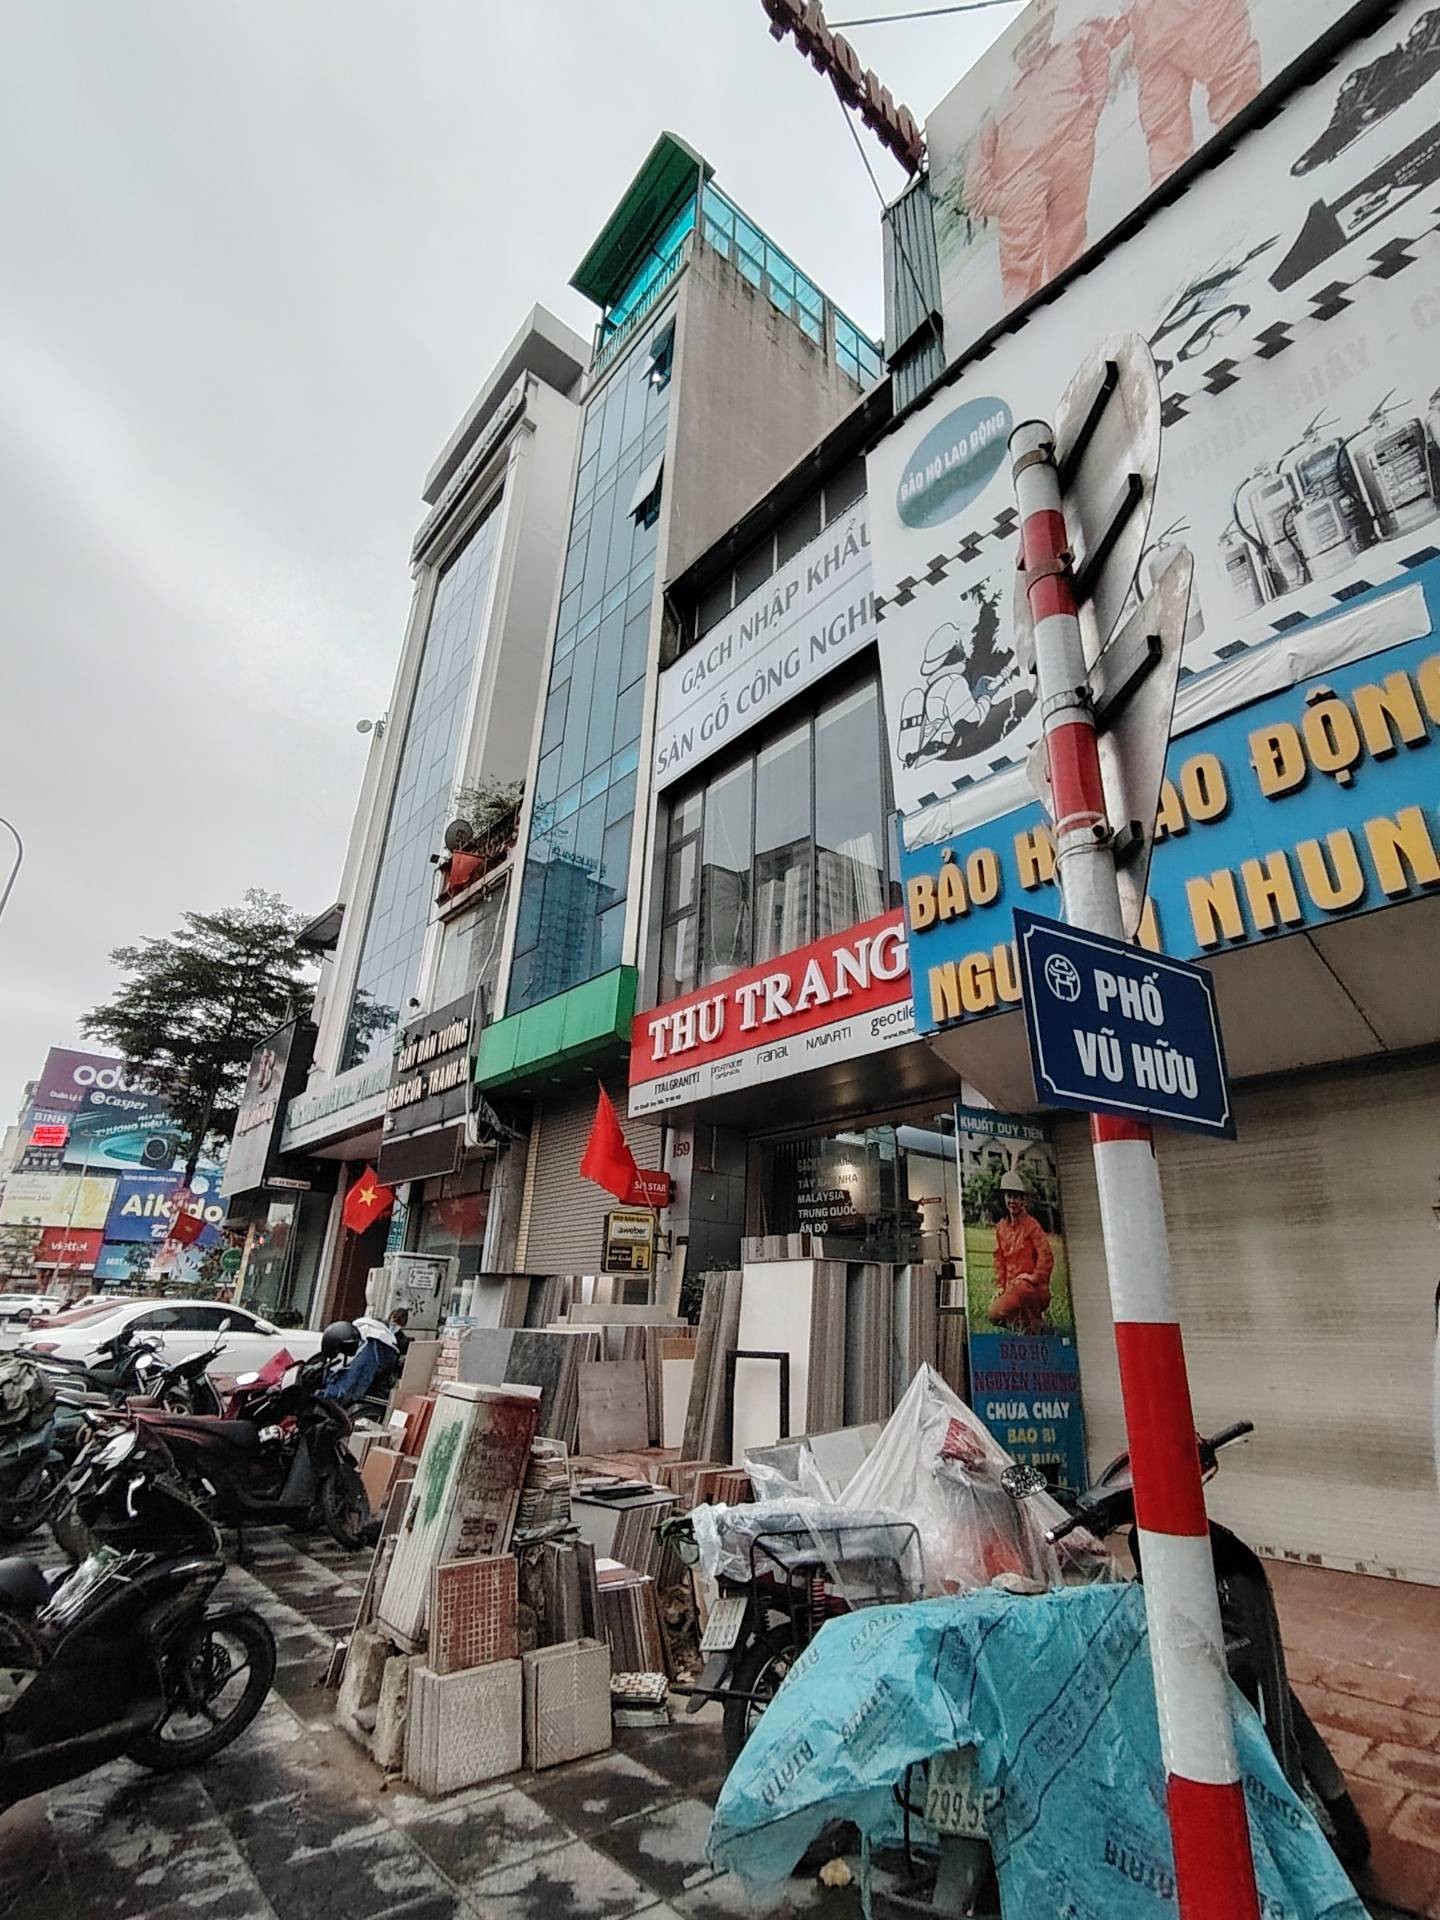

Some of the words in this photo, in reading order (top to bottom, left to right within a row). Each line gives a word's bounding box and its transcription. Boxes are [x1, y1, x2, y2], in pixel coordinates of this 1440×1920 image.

[944, 439, 967, 468] LAO
[969, 410, 1005, 449] ĐỘNG
[681, 635, 732, 694] GẠCH
[739, 580, 799, 649] NHẬP
[701, 691, 729, 742] GỖ
[736, 647, 800, 715] CÔNG
[907, 846, 999, 931] BẢO
[1014, 823, 1056, 891] H
[1152, 752, 1229, 840] AO
[1186, 807, 1440, 949] NHUN
[648, 994, 727, 1061] THU
[736, 923, 909, 1032] TRANG
[1094, 971, 1164, 1027] PHỐ
[1073, 1027, 1124, 1083] VŨ
[1131, 1039, 1199, 1099] HỮU
[655, 1072, 700, 1095] ITALGRANITI
[105, 1095, 148, 1110] Casper
[997, 1122, 1019, 1136] DUY
[672, 1142, 691, 1158] 159
[798, 1190, 845, 1203] MALAYSIA
[798, 1208, 828, 1219] TRUNG
[830, 1202, 857, 1216] QUỐC
[800, 1221, 812, 1233] ẤN
[815, 1221, 828, 1234] ĐỘ
[1032, 1398, 1069, 1419] CHÁY
[1008, 1427, 1037, 1444] BAO
